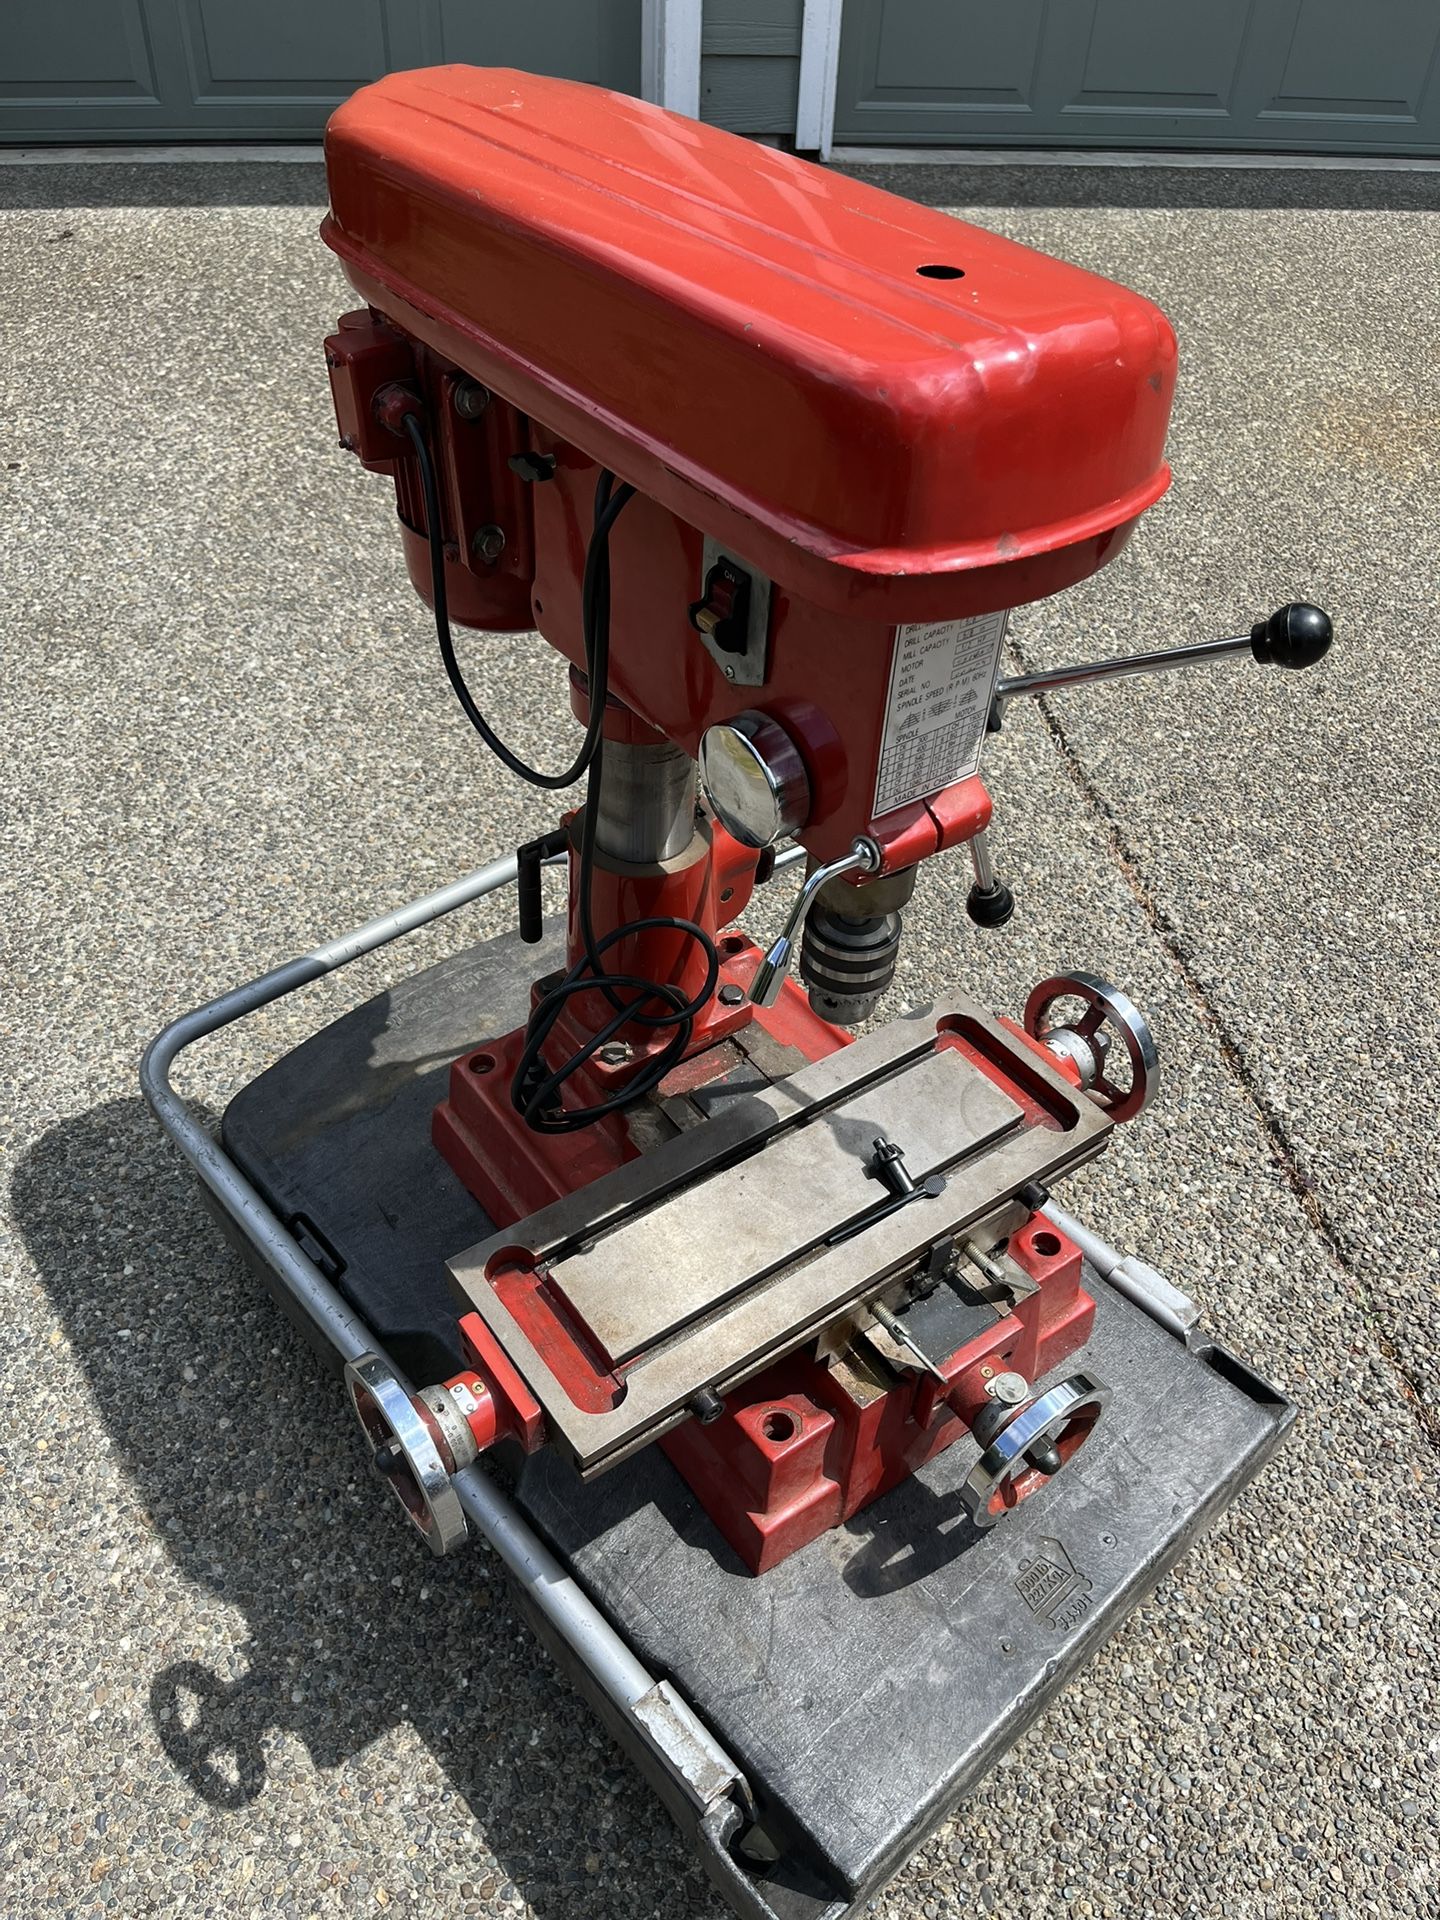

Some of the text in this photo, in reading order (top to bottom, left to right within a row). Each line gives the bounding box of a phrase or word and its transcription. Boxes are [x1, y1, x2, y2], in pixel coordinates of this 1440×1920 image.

[724, 570, 736, 583] ON
[904, 637, 920, 648] DRILL
[924, 625, 954, 641] CAPACITY
[903, 650, 916, 662] MILL
[920, 638, 950, 655] CAPACITY
[901, 659, 924, 674] MOTOR
[897, 680, 931, 700] SERIAL NO
[898, 675, 916, 688] DATE
[896, 694, 923, 713] SPINDLE
[924, 687, 945, 702] SPEED
[955, 706, 976, 720] MOTOR
[896, 728, 920, 744] SPINDLE
[894, 788, 917, 804] MADE
[921, 782, 930, 792] IN
[934, 770, 958, 787] CHINA
[1027, 1583, 1046, 1604] 227
